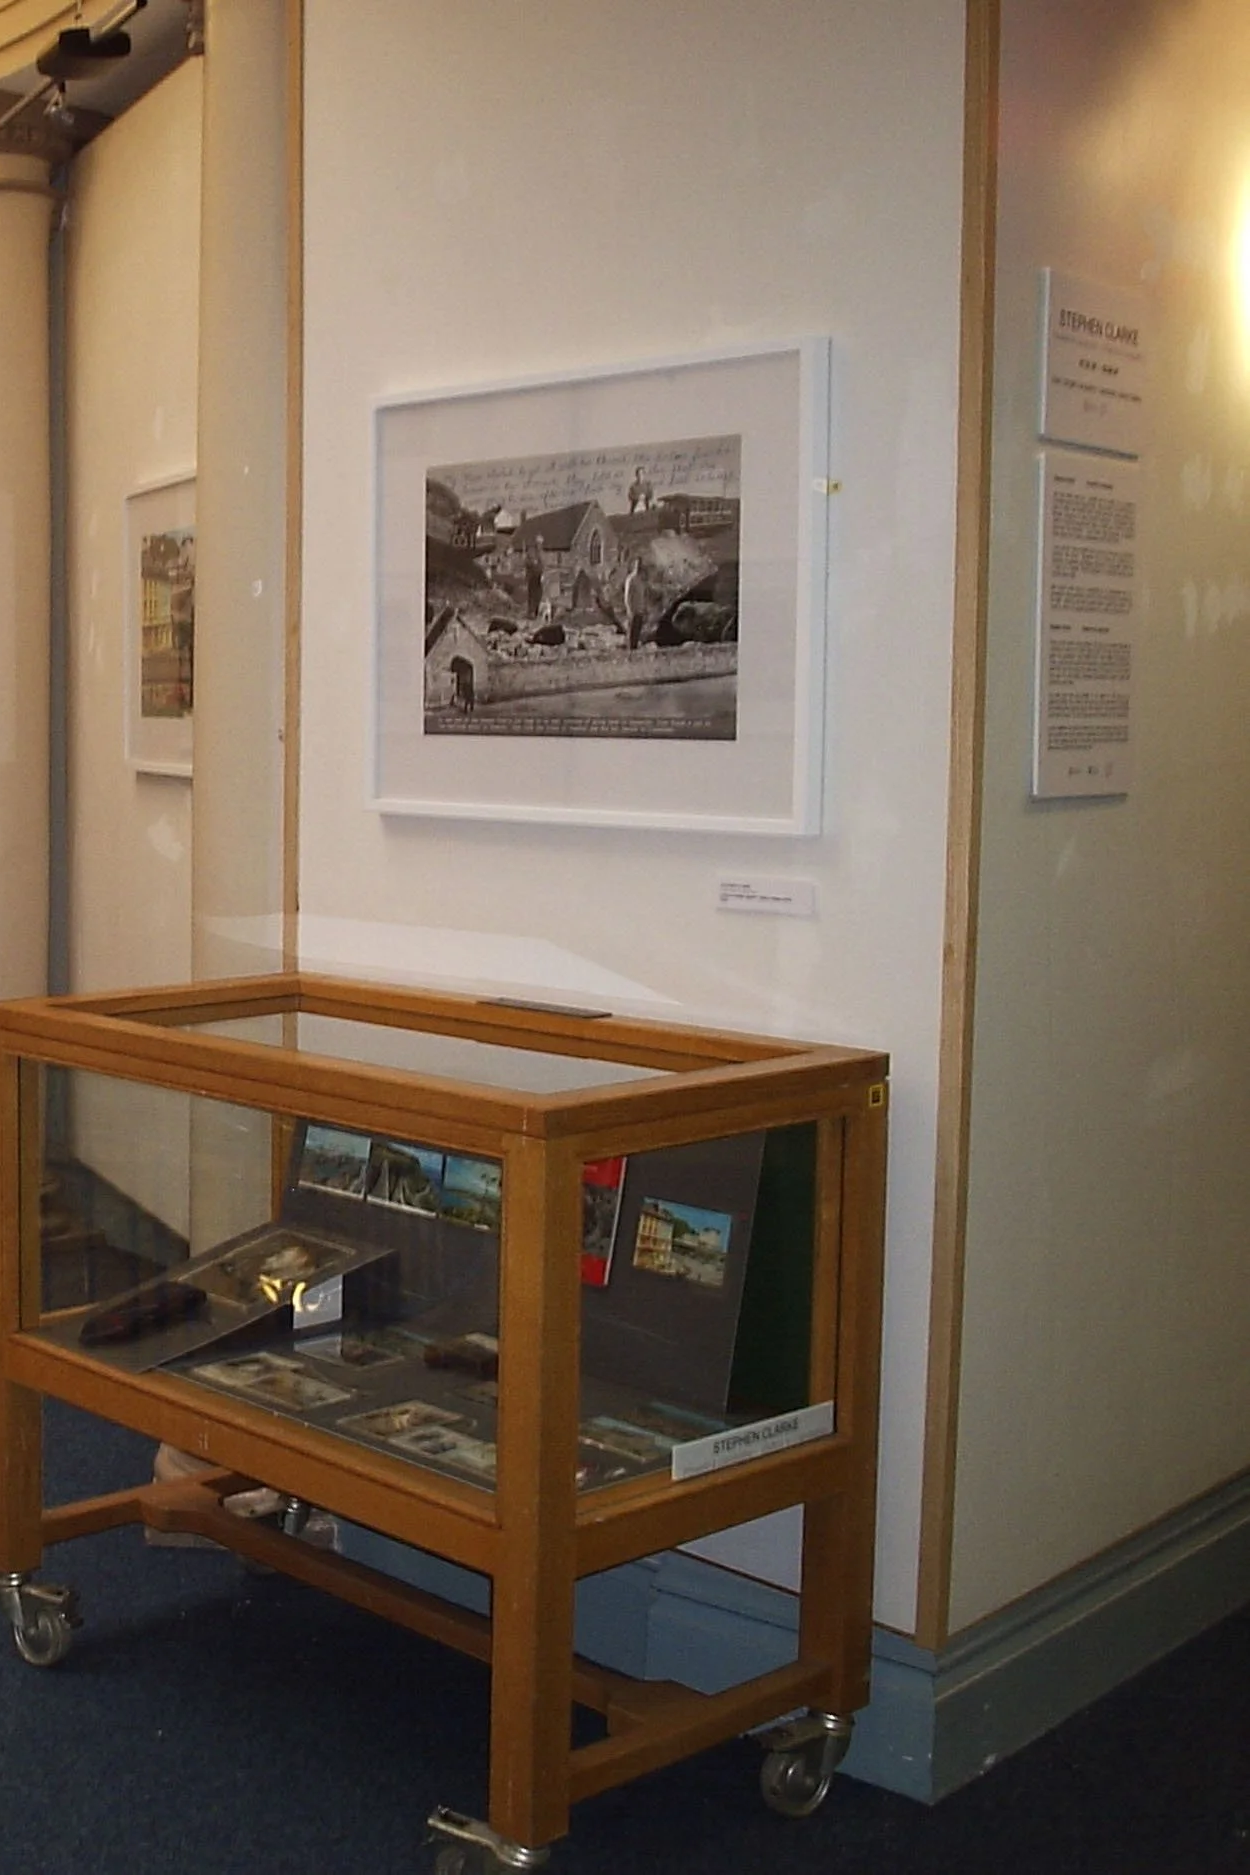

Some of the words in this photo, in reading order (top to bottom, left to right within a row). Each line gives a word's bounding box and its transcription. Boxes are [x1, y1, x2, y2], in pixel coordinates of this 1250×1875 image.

[1060, 309, 1103, 336] STEPHEN
[1105, 321, 1139, 346] CLARKE
[713, 1432, 760, 1454] STEPHEN
[762, 1417, 799, 1439] CLARKE
